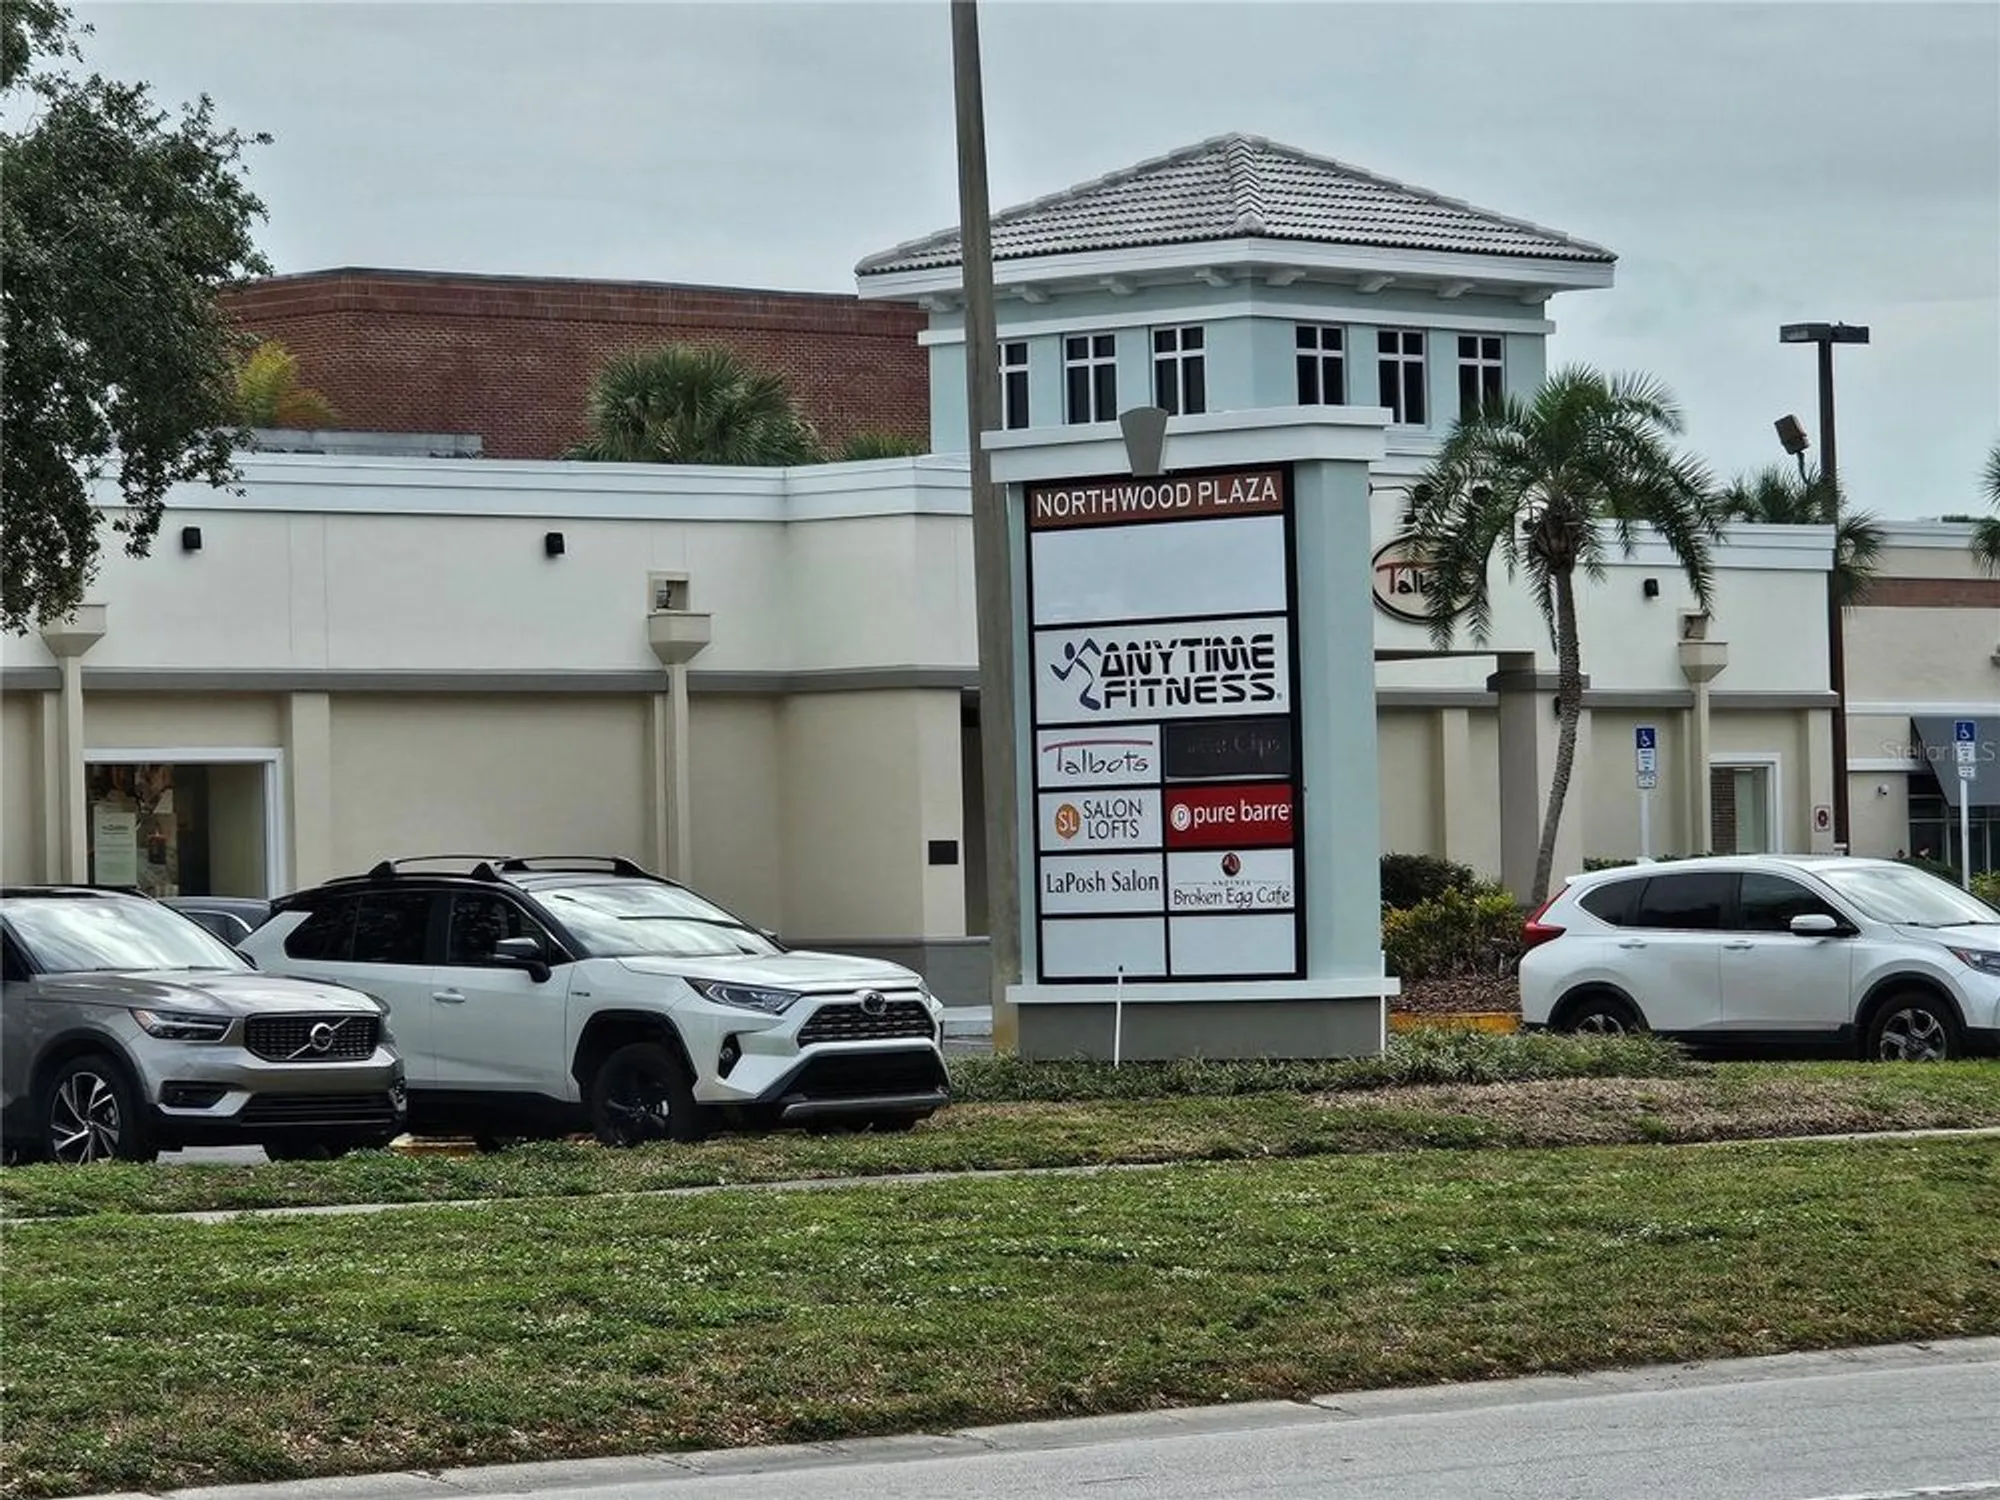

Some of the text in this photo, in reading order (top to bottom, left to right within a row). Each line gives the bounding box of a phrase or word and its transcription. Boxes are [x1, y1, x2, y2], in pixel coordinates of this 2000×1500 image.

[1036, 476, 1278, 518] NORTHWOOD PLAZA
[1100, 633, 1275, 677] ANYTIME
[1104, 672, 1275, 709] FITNESS
[1043, 739, 1154, 775] Talbots
[1083, 798, 1143, 819] SALON
[1193, 798, 1290, 829] pure barre
[1088, 818, 1140, 839] LOFTS
[1046, 868, 1160, 893] LaPosh Salon
[1174, 887, 1223, 906] Broken
[1226, 887, 1254, 911] Egg
